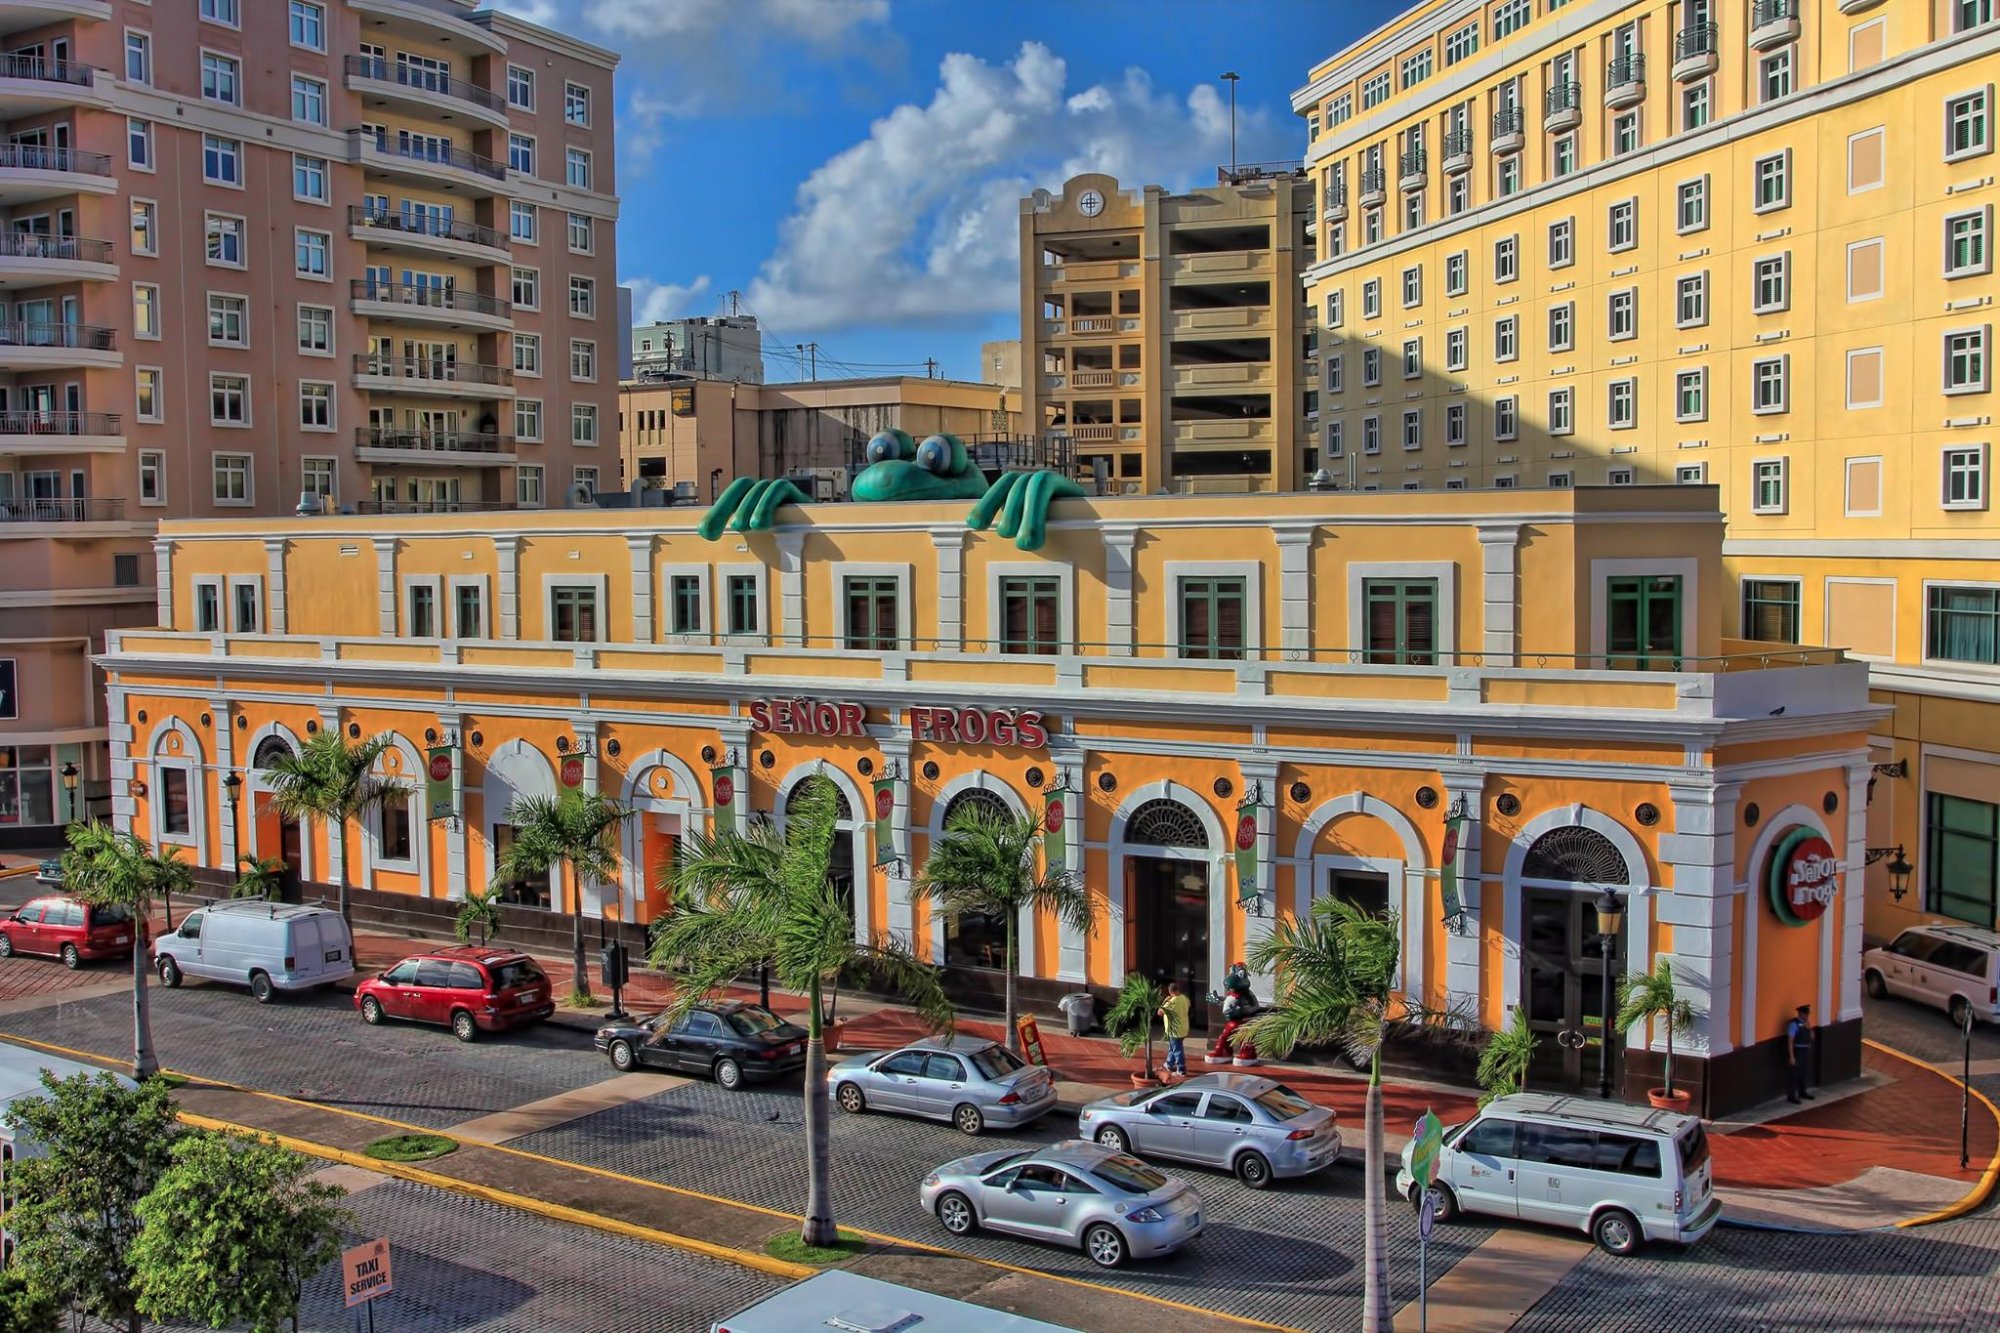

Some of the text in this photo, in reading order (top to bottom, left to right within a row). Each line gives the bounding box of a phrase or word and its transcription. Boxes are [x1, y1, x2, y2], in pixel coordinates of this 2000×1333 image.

[750, 696, 1048, 748] SEÑOR FROG'S
[1791, 853, 1838, 885] Señor
[355, 1257, 379, 1277] TAXI
[350, 1271, 387, 1295] SERVICE
